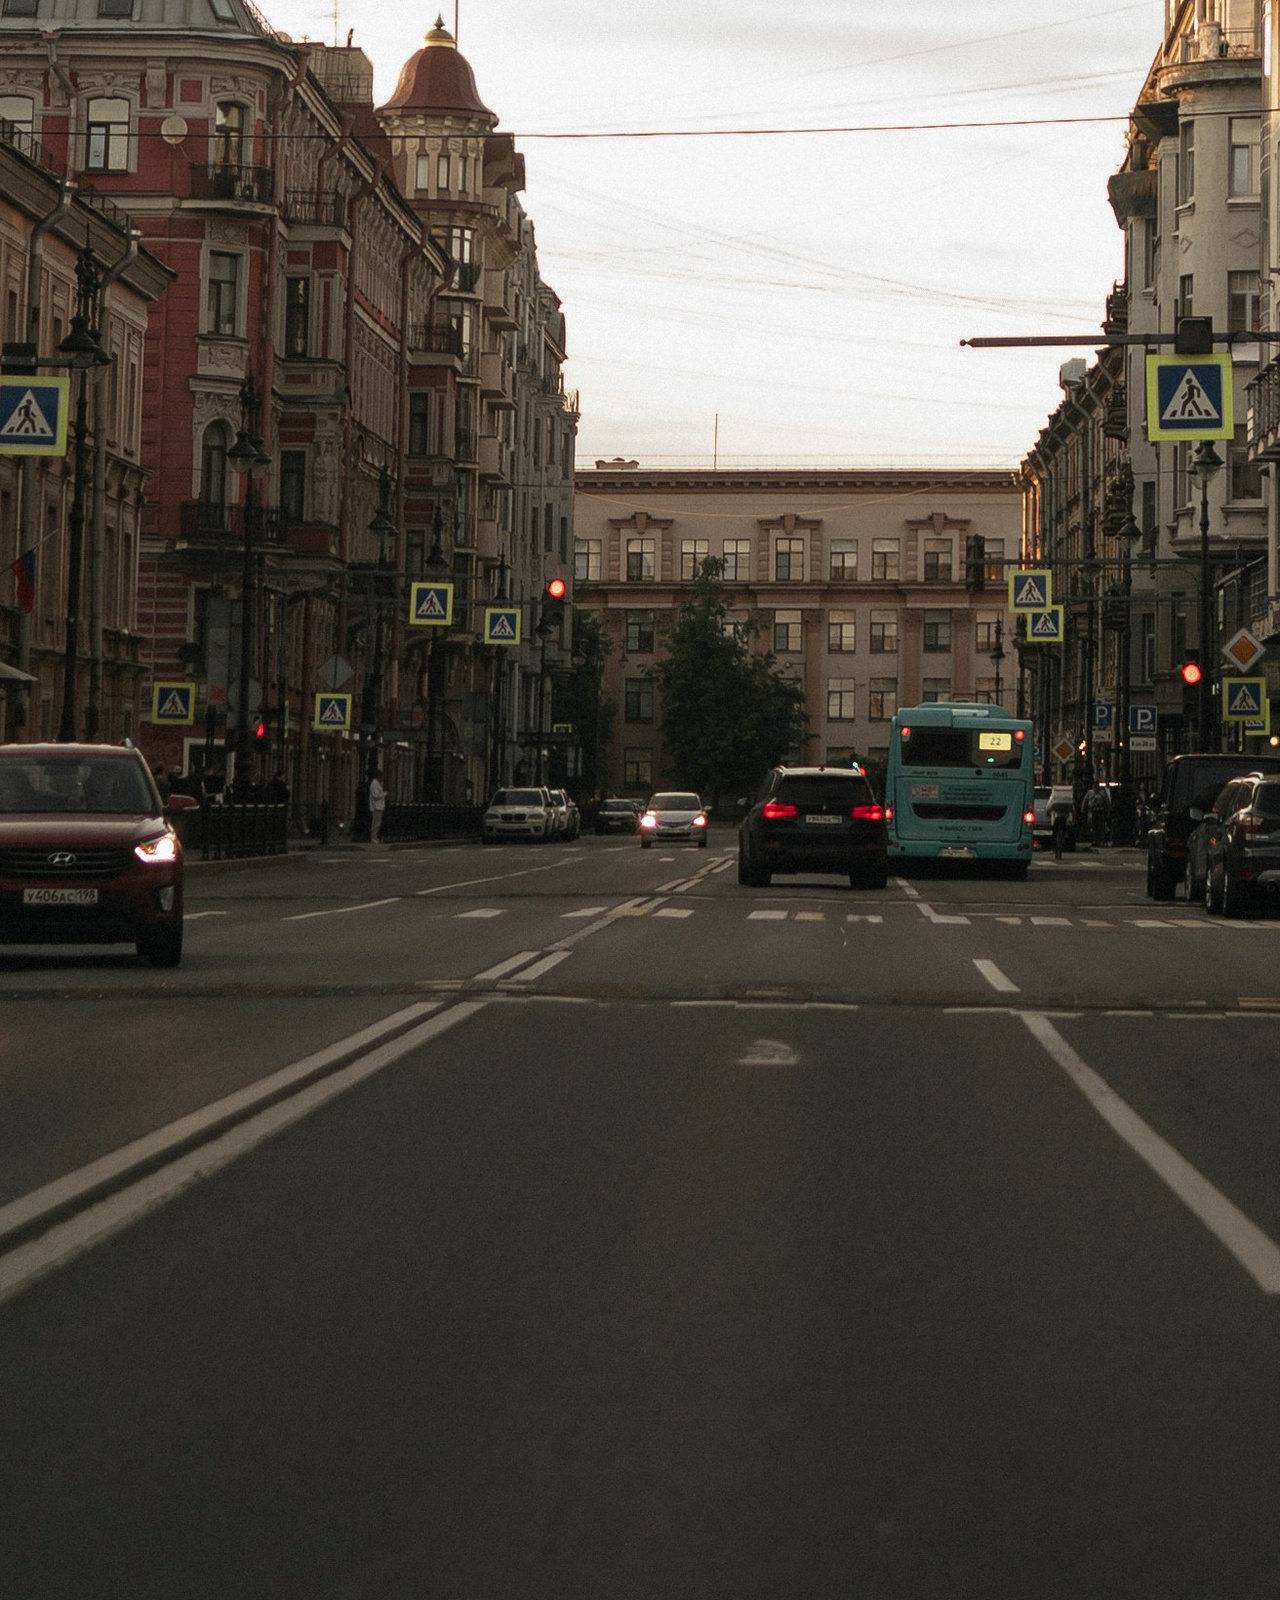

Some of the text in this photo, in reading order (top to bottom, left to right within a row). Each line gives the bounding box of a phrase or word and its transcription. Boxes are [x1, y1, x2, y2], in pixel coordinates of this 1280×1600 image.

[1137, 709, 1152, 730] P
[989, 737, 1001, 746] 22
[27, 890, 74, 902] У406АС
